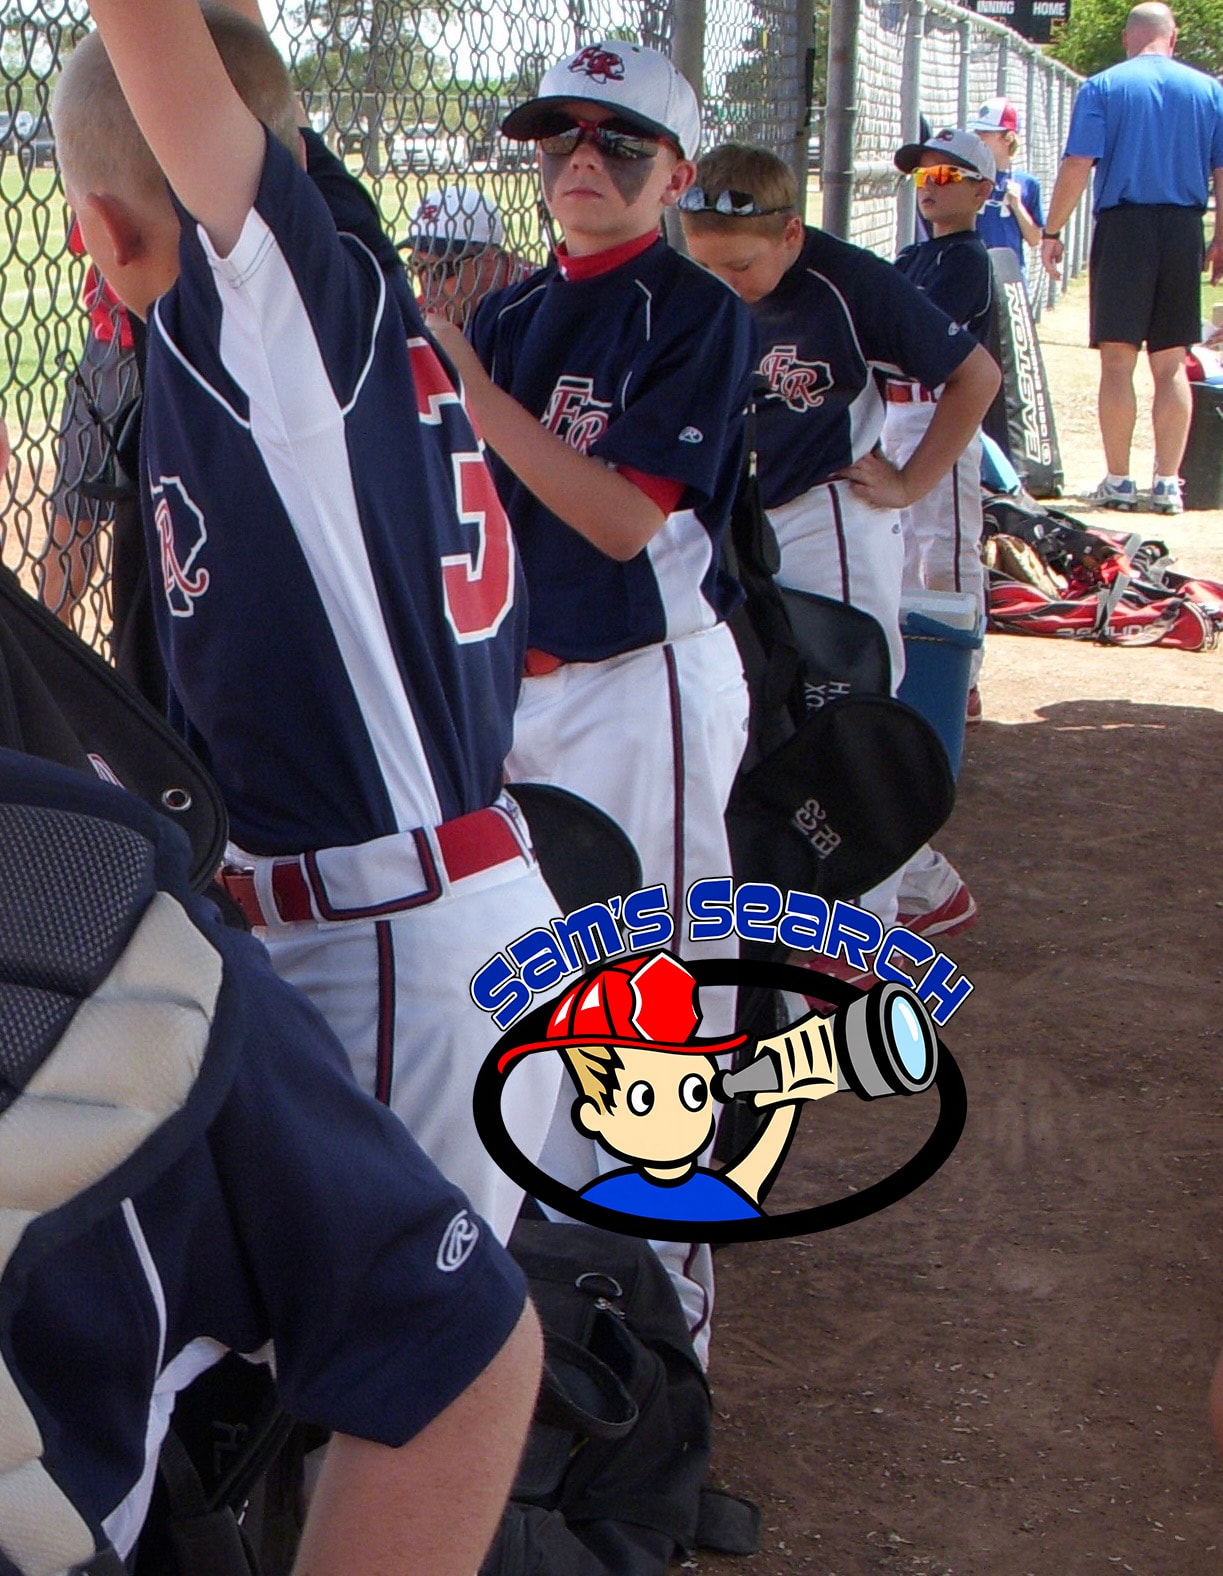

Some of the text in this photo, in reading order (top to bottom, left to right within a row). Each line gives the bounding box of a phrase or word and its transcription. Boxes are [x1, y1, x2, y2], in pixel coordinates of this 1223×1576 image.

[977, 1, 1066, 16] INNING HOME
[1003, 281, 1042, 464] EASTON
